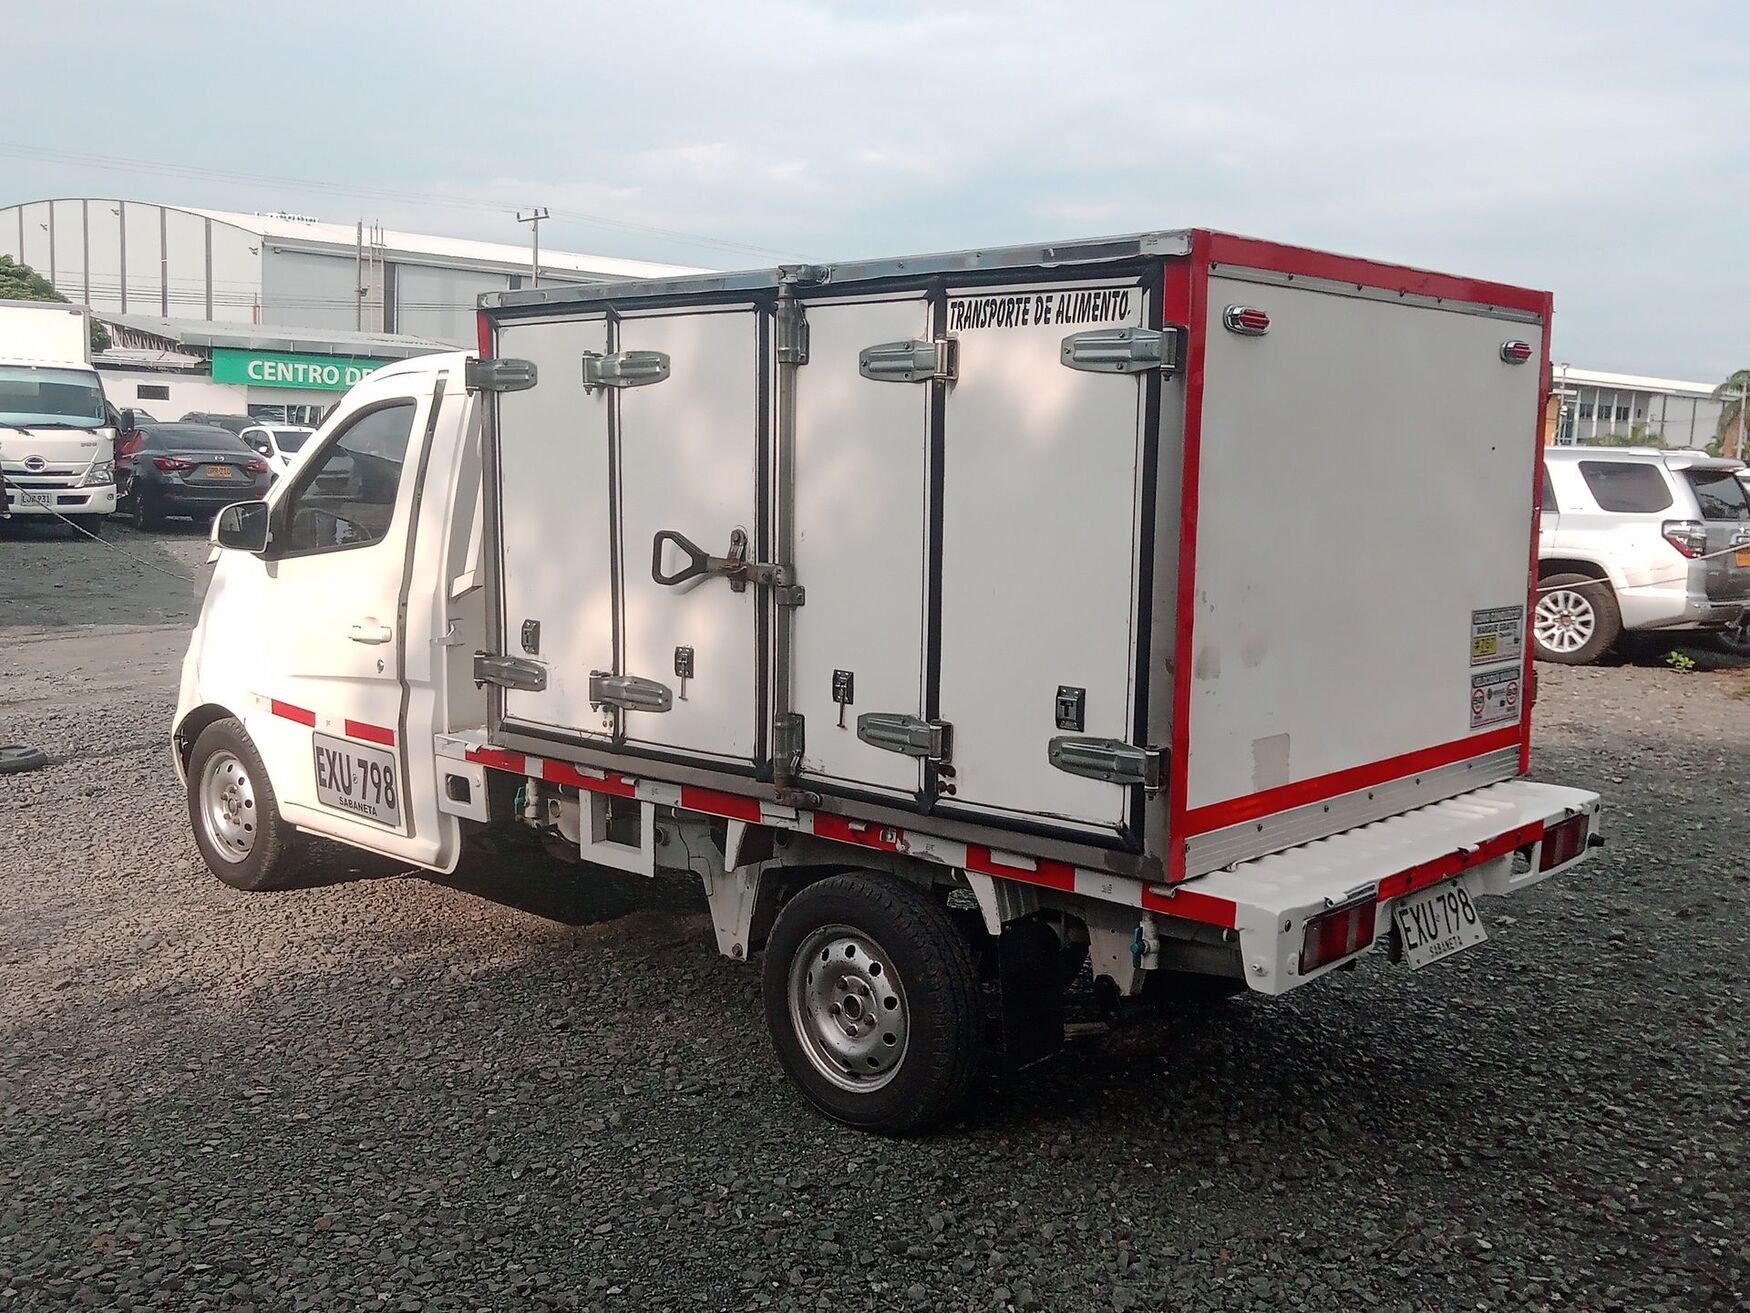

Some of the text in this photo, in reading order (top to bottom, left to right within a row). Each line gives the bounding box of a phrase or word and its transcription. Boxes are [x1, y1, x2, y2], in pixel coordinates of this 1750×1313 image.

[949, 296, 1031, 331] TRANSPORTE
[1034, 295, 1053, 326] DE
[247, 360, 340, 385] CENTRO
[315, 745, 395, 810] EXU 798
[339, 796, 377, 816] SABANETA
[1398, 888, 1475, 950] EXU 798
[1429, 935, 1463, 957] SABANETA
